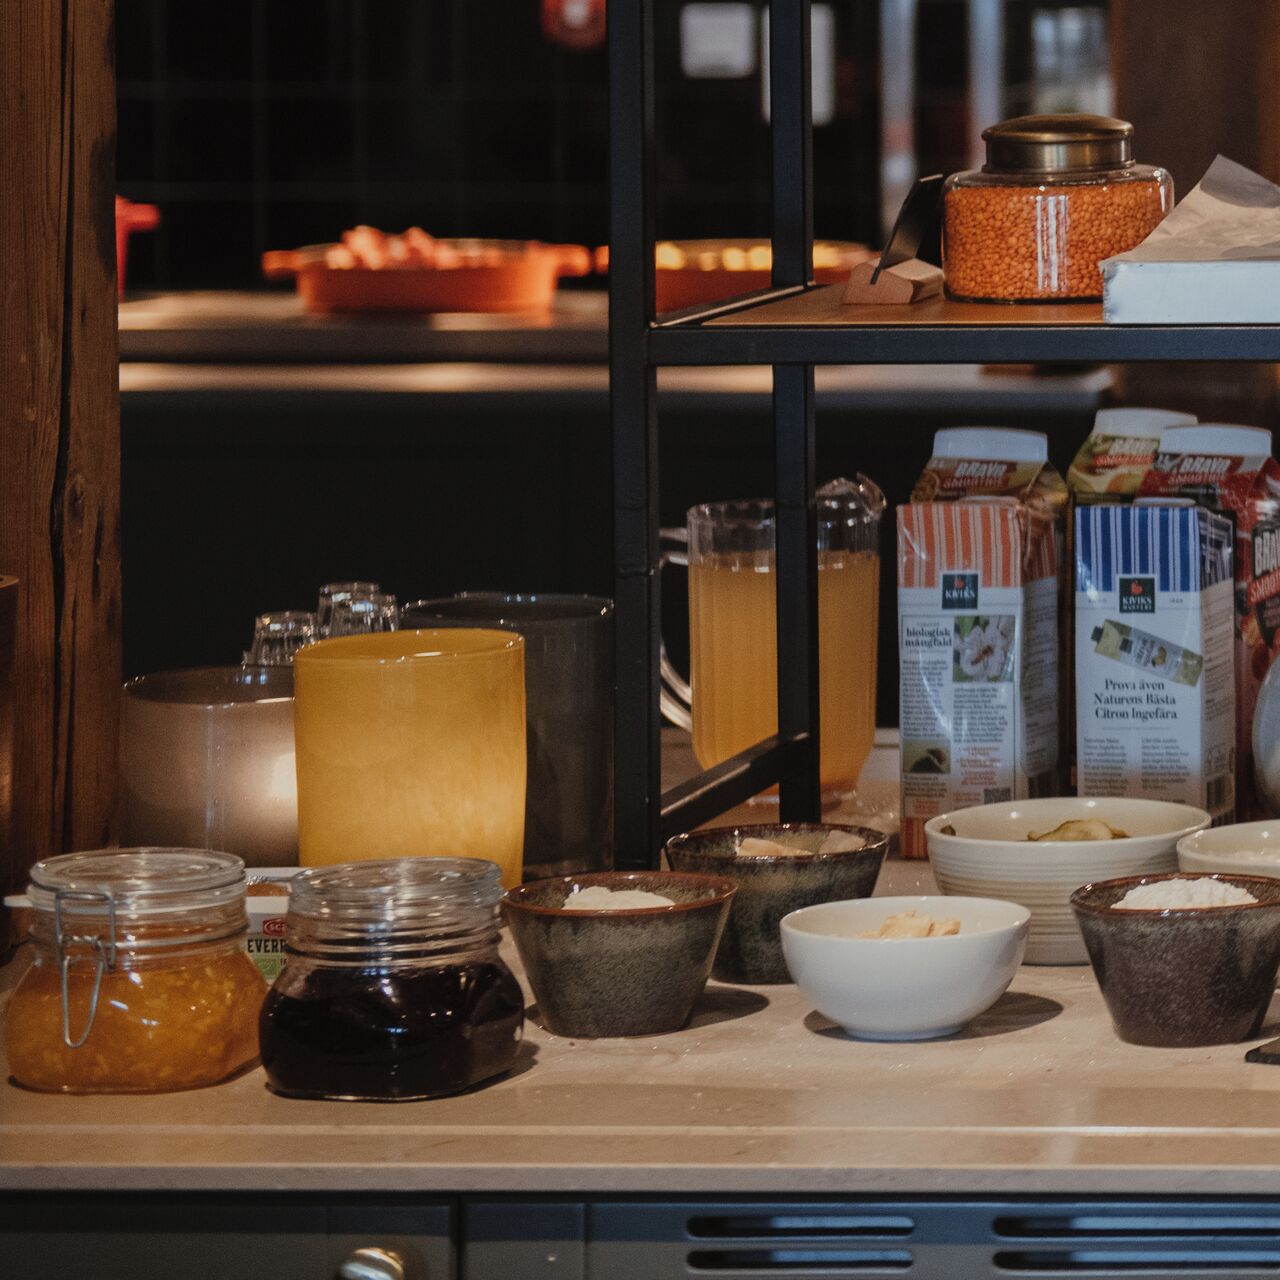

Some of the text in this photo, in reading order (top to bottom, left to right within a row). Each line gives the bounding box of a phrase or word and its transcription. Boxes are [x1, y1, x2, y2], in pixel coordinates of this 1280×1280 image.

[956, 461, 1008, 478] BRAVO
[1179, 456, 1231, 474] BRAVO
[1122, 594, 1152, 605] KIVIKS
[906, 626, 951, 638] biologisk
[905, 637, 952, 648] mångfald
[1104, 679, 1165, 691] Prova även
[1094, 692, 1177, 705] Naturens Bästa
[1095, 706, 1178, 722] Citron Ingefära
